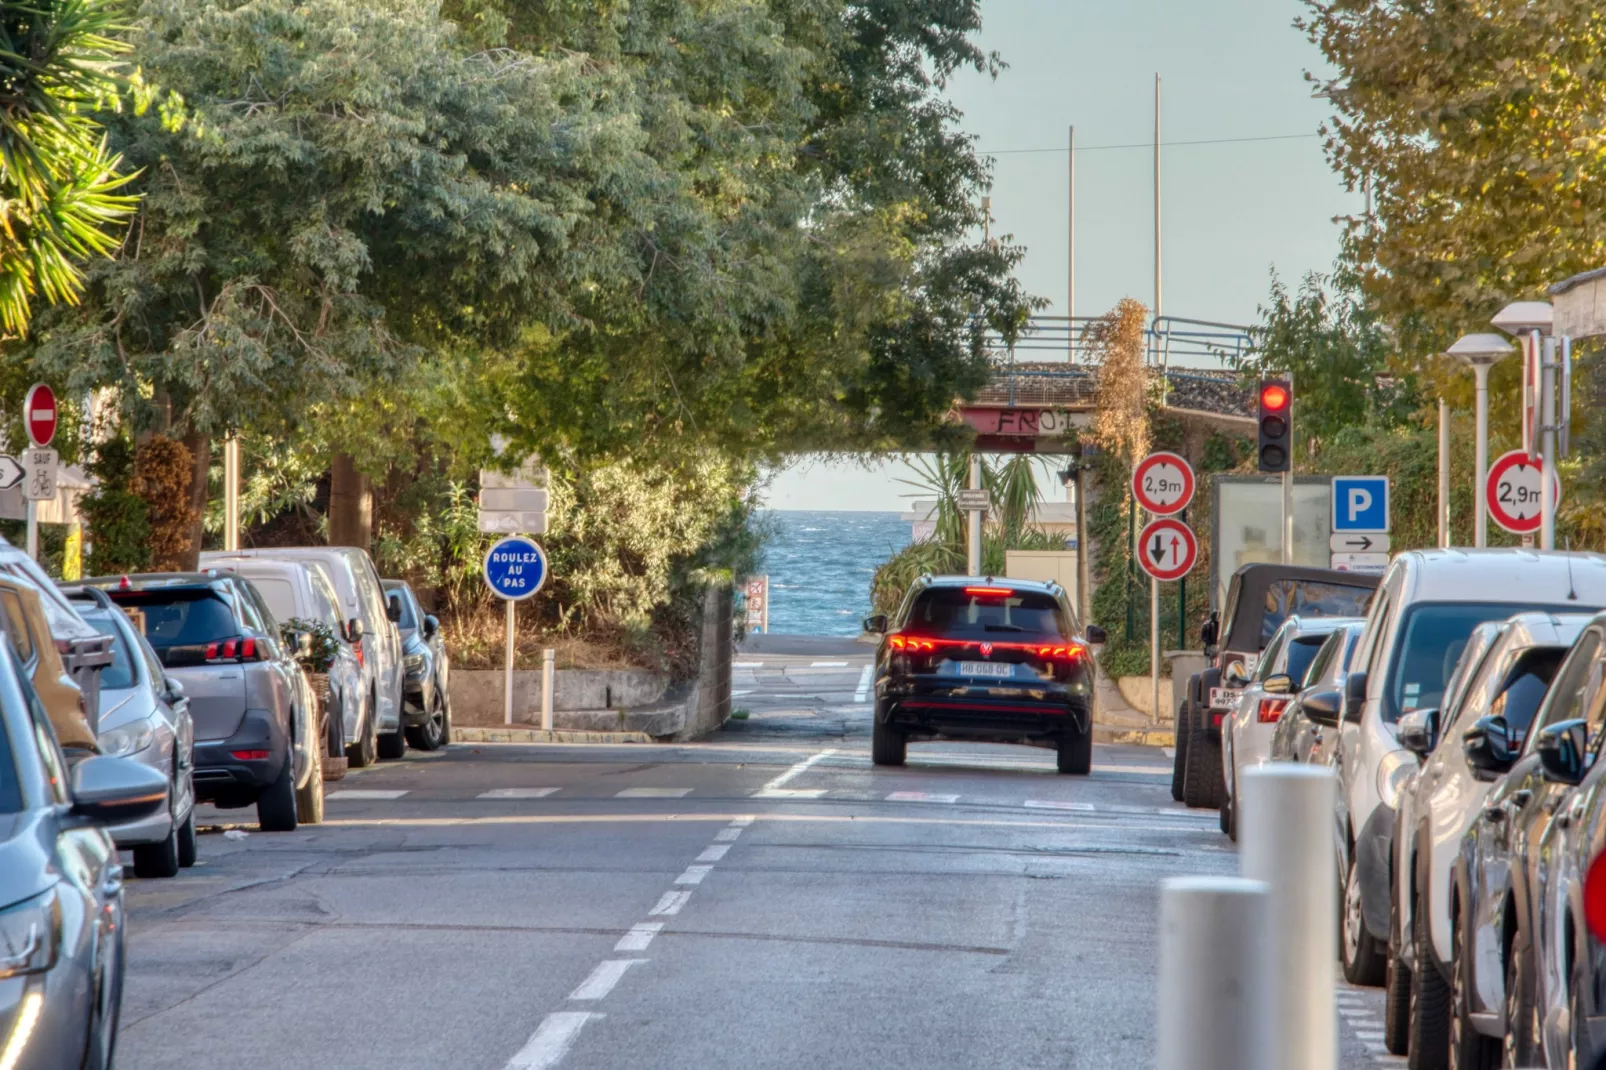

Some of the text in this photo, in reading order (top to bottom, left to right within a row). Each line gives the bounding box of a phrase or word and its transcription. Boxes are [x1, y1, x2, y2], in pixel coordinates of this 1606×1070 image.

[34, 453, 51, 464] SAUF
[1145, 476, 1182, 494] 2,9m
[1348, 488, 1373, 522] P
[493, 552, 537, 563] ROULEZ
[508, 564, 523, 575] AU
[504, 578, 525, 588] PAS
